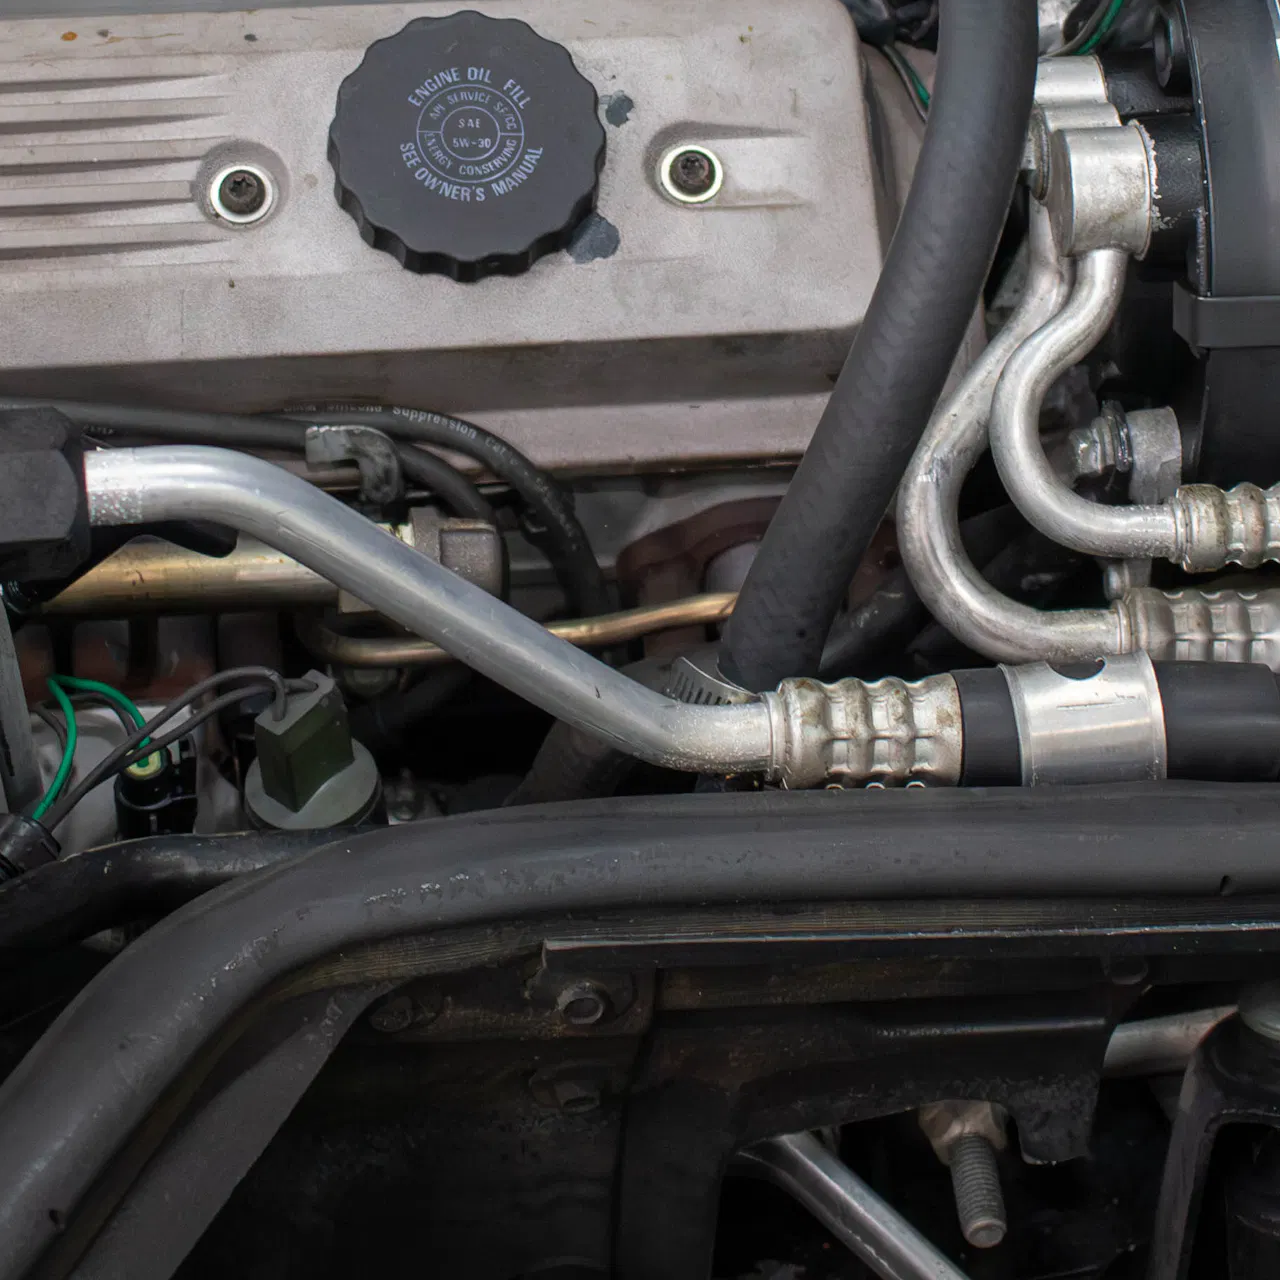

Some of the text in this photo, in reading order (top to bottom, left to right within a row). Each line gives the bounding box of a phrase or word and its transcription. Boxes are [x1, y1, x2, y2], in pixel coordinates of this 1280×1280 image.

[407, 66, 532, 110] ENGINE OIL FILL
[447, 91, 493, 106] SERVICE
[458, 118, 481, 129] SAE
[423, 131, 518, 176] ENERGY CONSERVING
[452, 137, 492, 149] 5W-30
[400, 142, 543, 202] SEE OWNER'S MANUAL
[392, 406, 477, 440] Suppression
